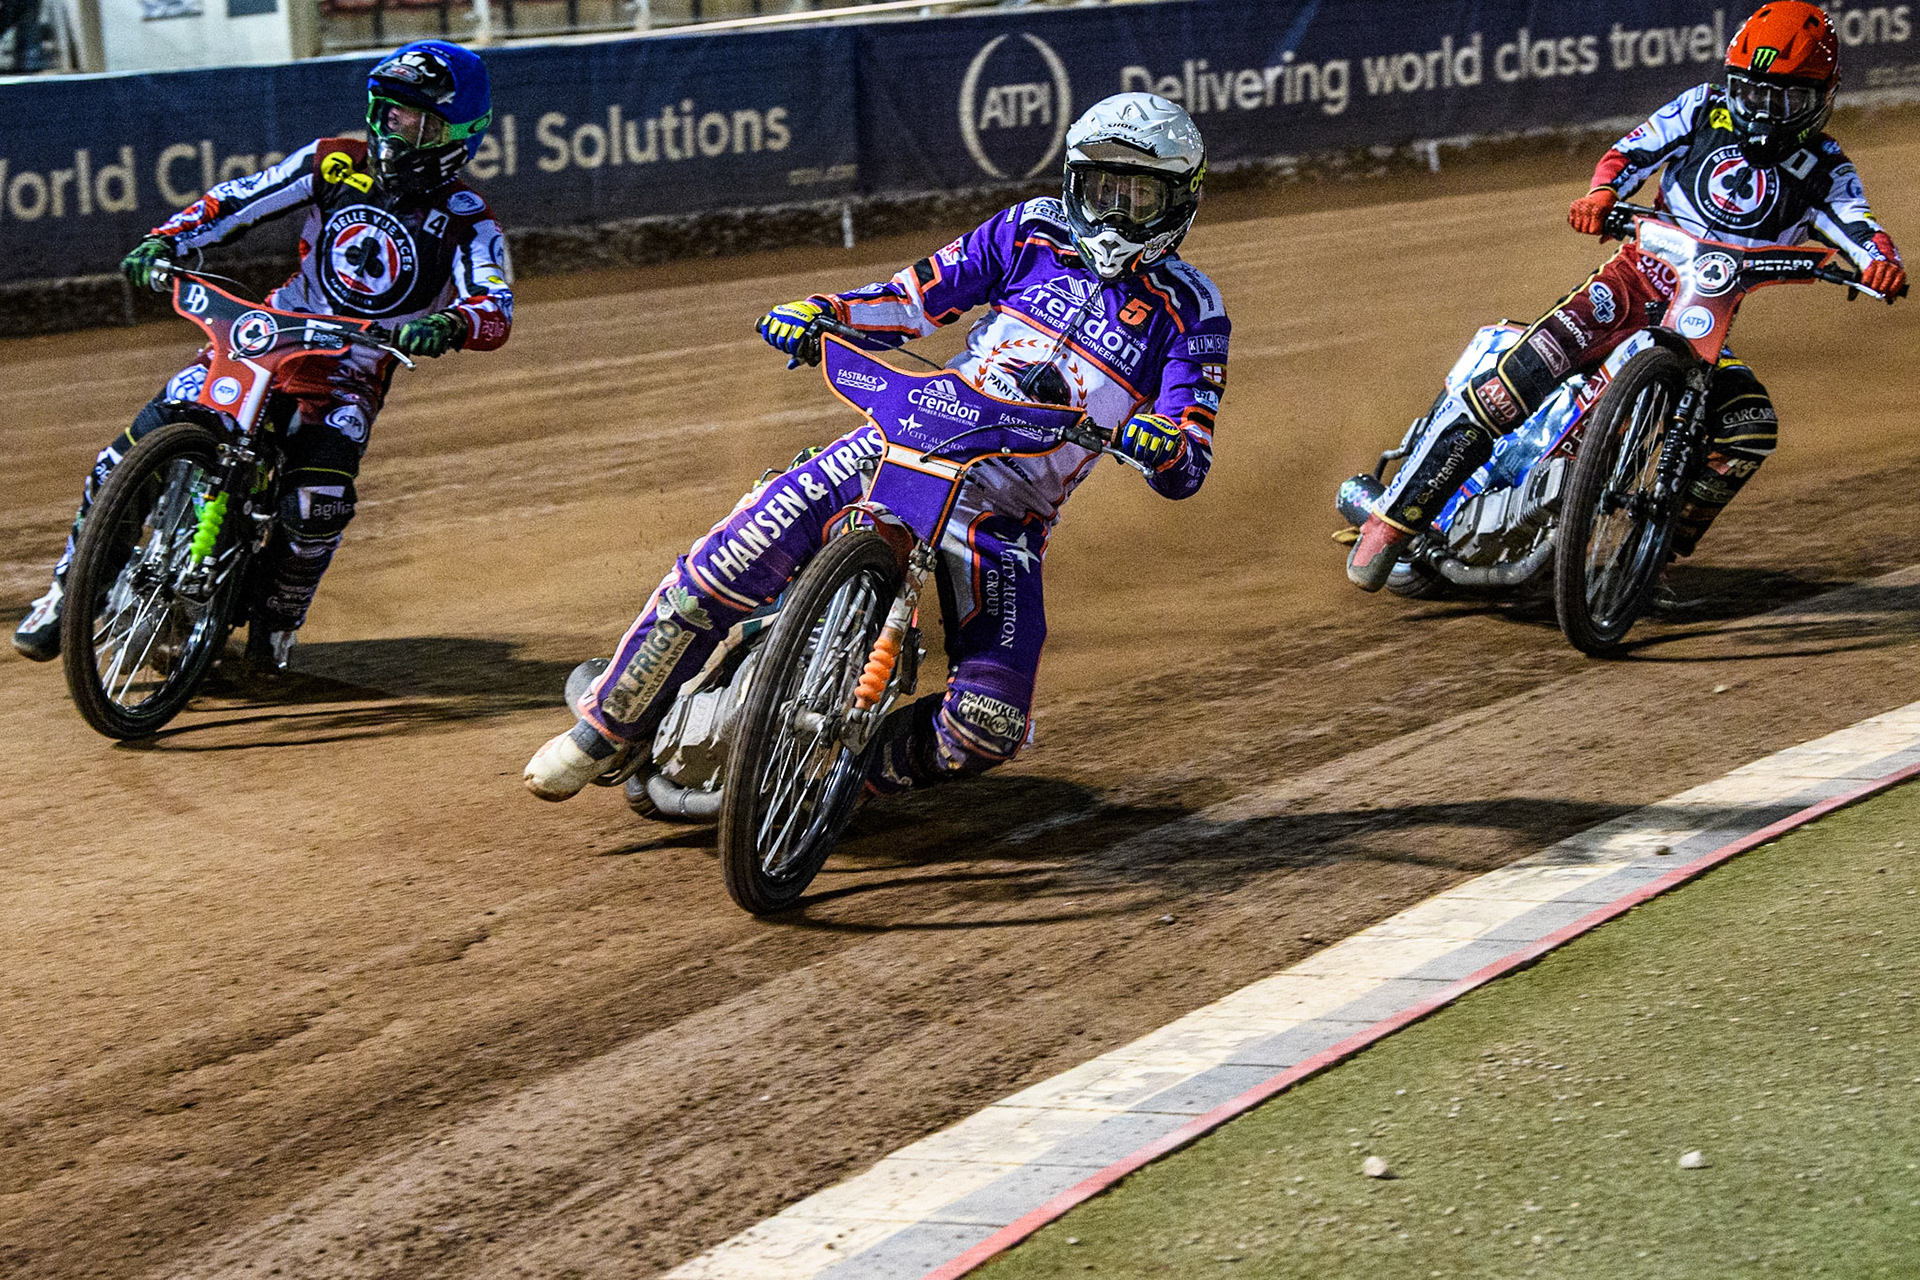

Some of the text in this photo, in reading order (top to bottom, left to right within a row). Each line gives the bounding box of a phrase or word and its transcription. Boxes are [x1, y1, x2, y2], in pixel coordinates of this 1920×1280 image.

[1363, 31, 1483, 95] world
[1495, 28, 1598, 82] class
[1609, 9, 1725, 70] travel
[979, 83, 1051, 130] ATPI
[535, 98, 791, 172] Solutions
[1712, 149, 1743, 163] BELL
[0, 145, 138, 221] orld
[331, 211, 413, 272] BELLE VUE ACES
[428, 214, 447, 235] 4
[1019, 284, 1142, 367] Crendon
[1119, 298, 1153, 326] 5
[1683, 315, 1706, 328] ATPI
[1029, 304, 1133, 376] TIMBER ENGINEERING
[837, 369, 879, 385] FASTRACK
[1486, 381, 1518, 419] AMD
[907, 388, 981, 423] Crendon
[917, 406, 977, 428] TIMBER ENGINEERING
[909, 430, 929, 441] CITY
[709, 485, 810, 582] HANSEN
[797, 472, 829, 501] &
[986, 569, 999, 616] GROUP
[1000, 582, 1018, 649] AUCTION
